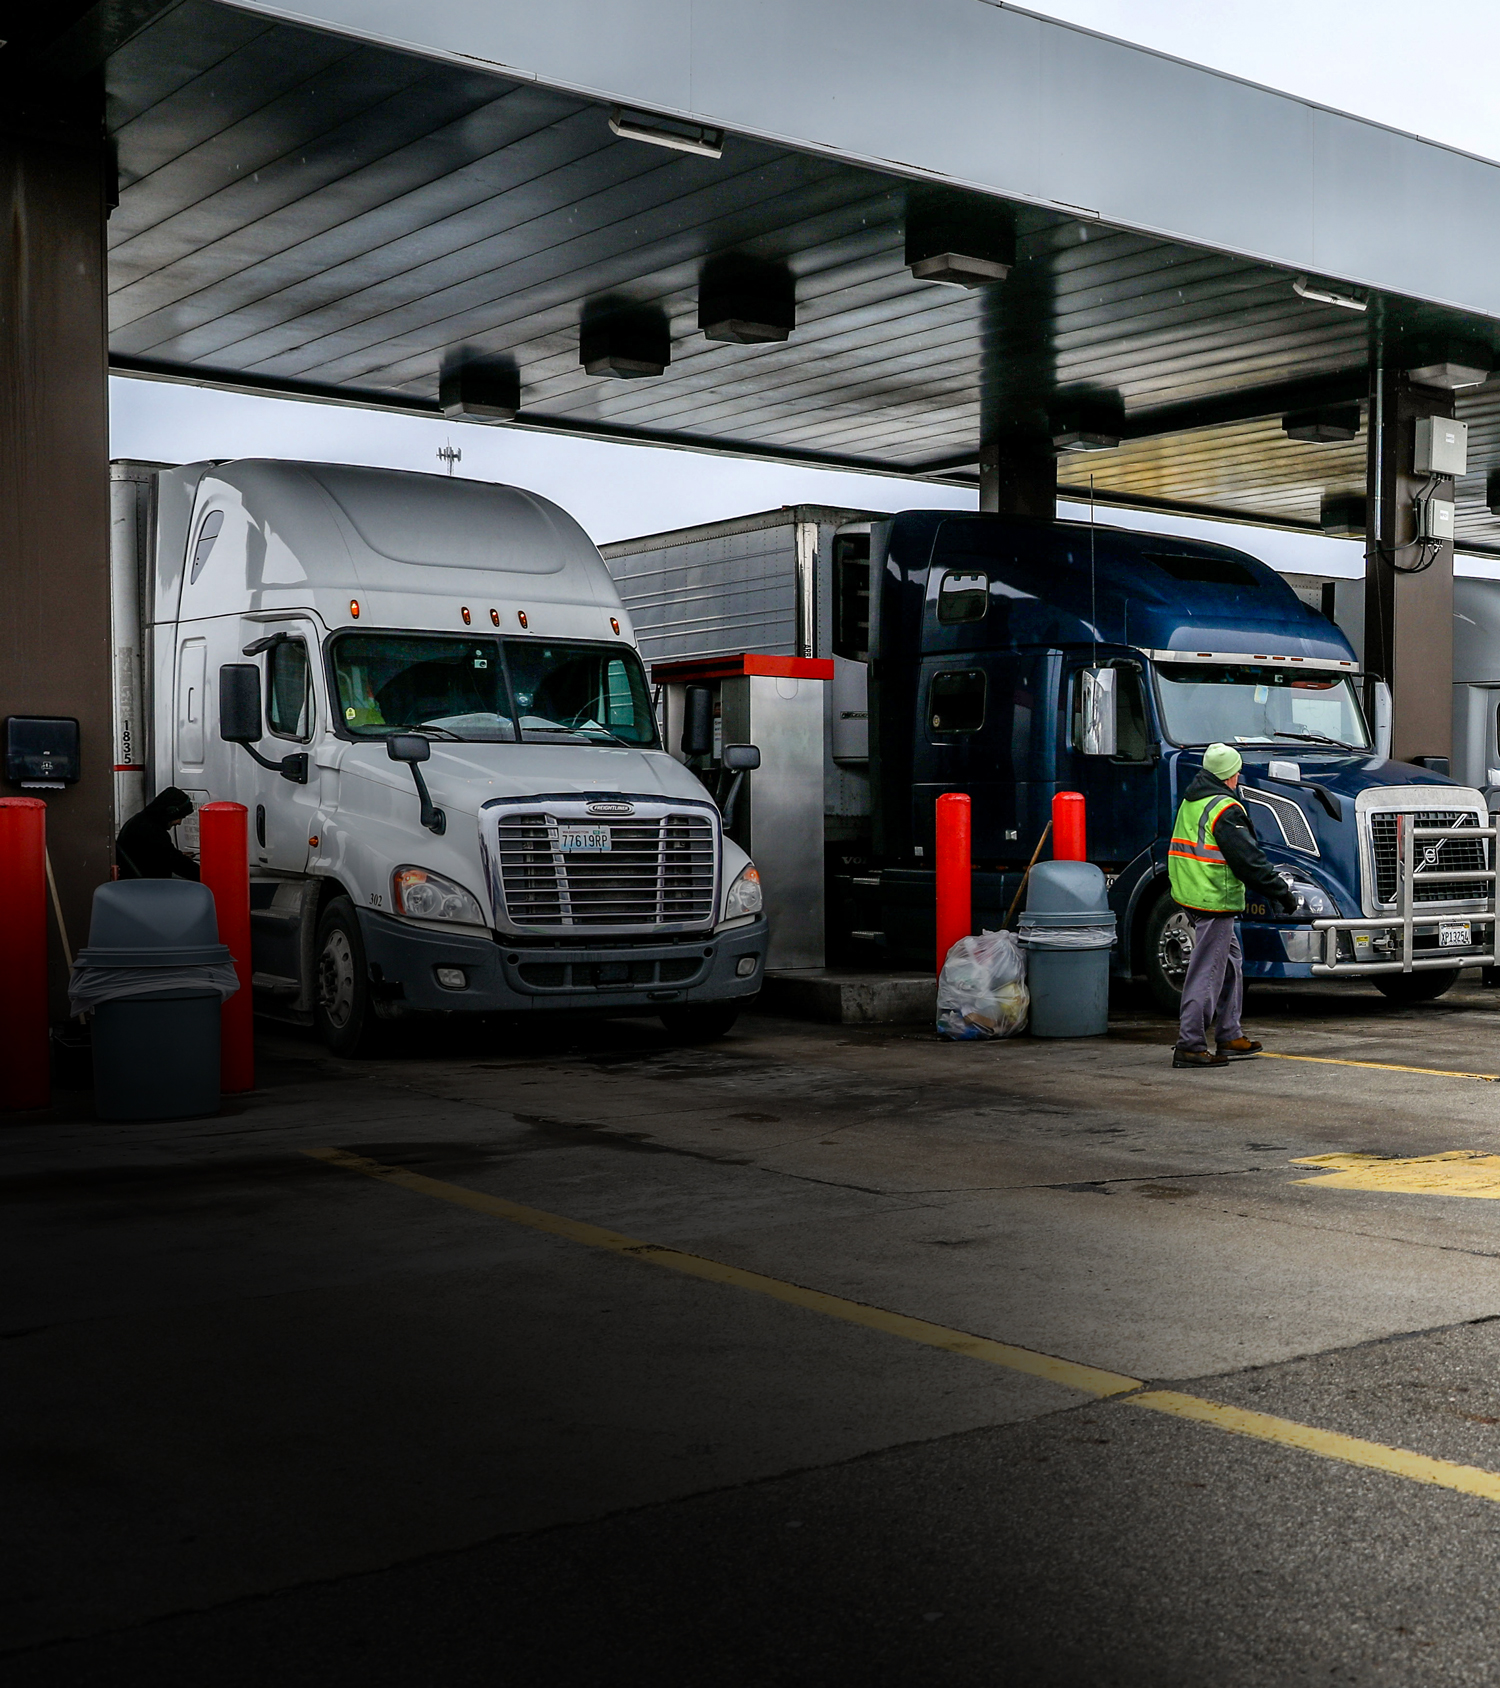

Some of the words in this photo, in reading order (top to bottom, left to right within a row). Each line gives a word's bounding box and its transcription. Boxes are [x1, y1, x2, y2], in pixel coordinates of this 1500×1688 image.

[122, 720, 132, 764] 1835
[562, 834, 608, 847] 77619RP
[369, 892, 383, 907] 302
[1245, 903, 1266, 915] 106
